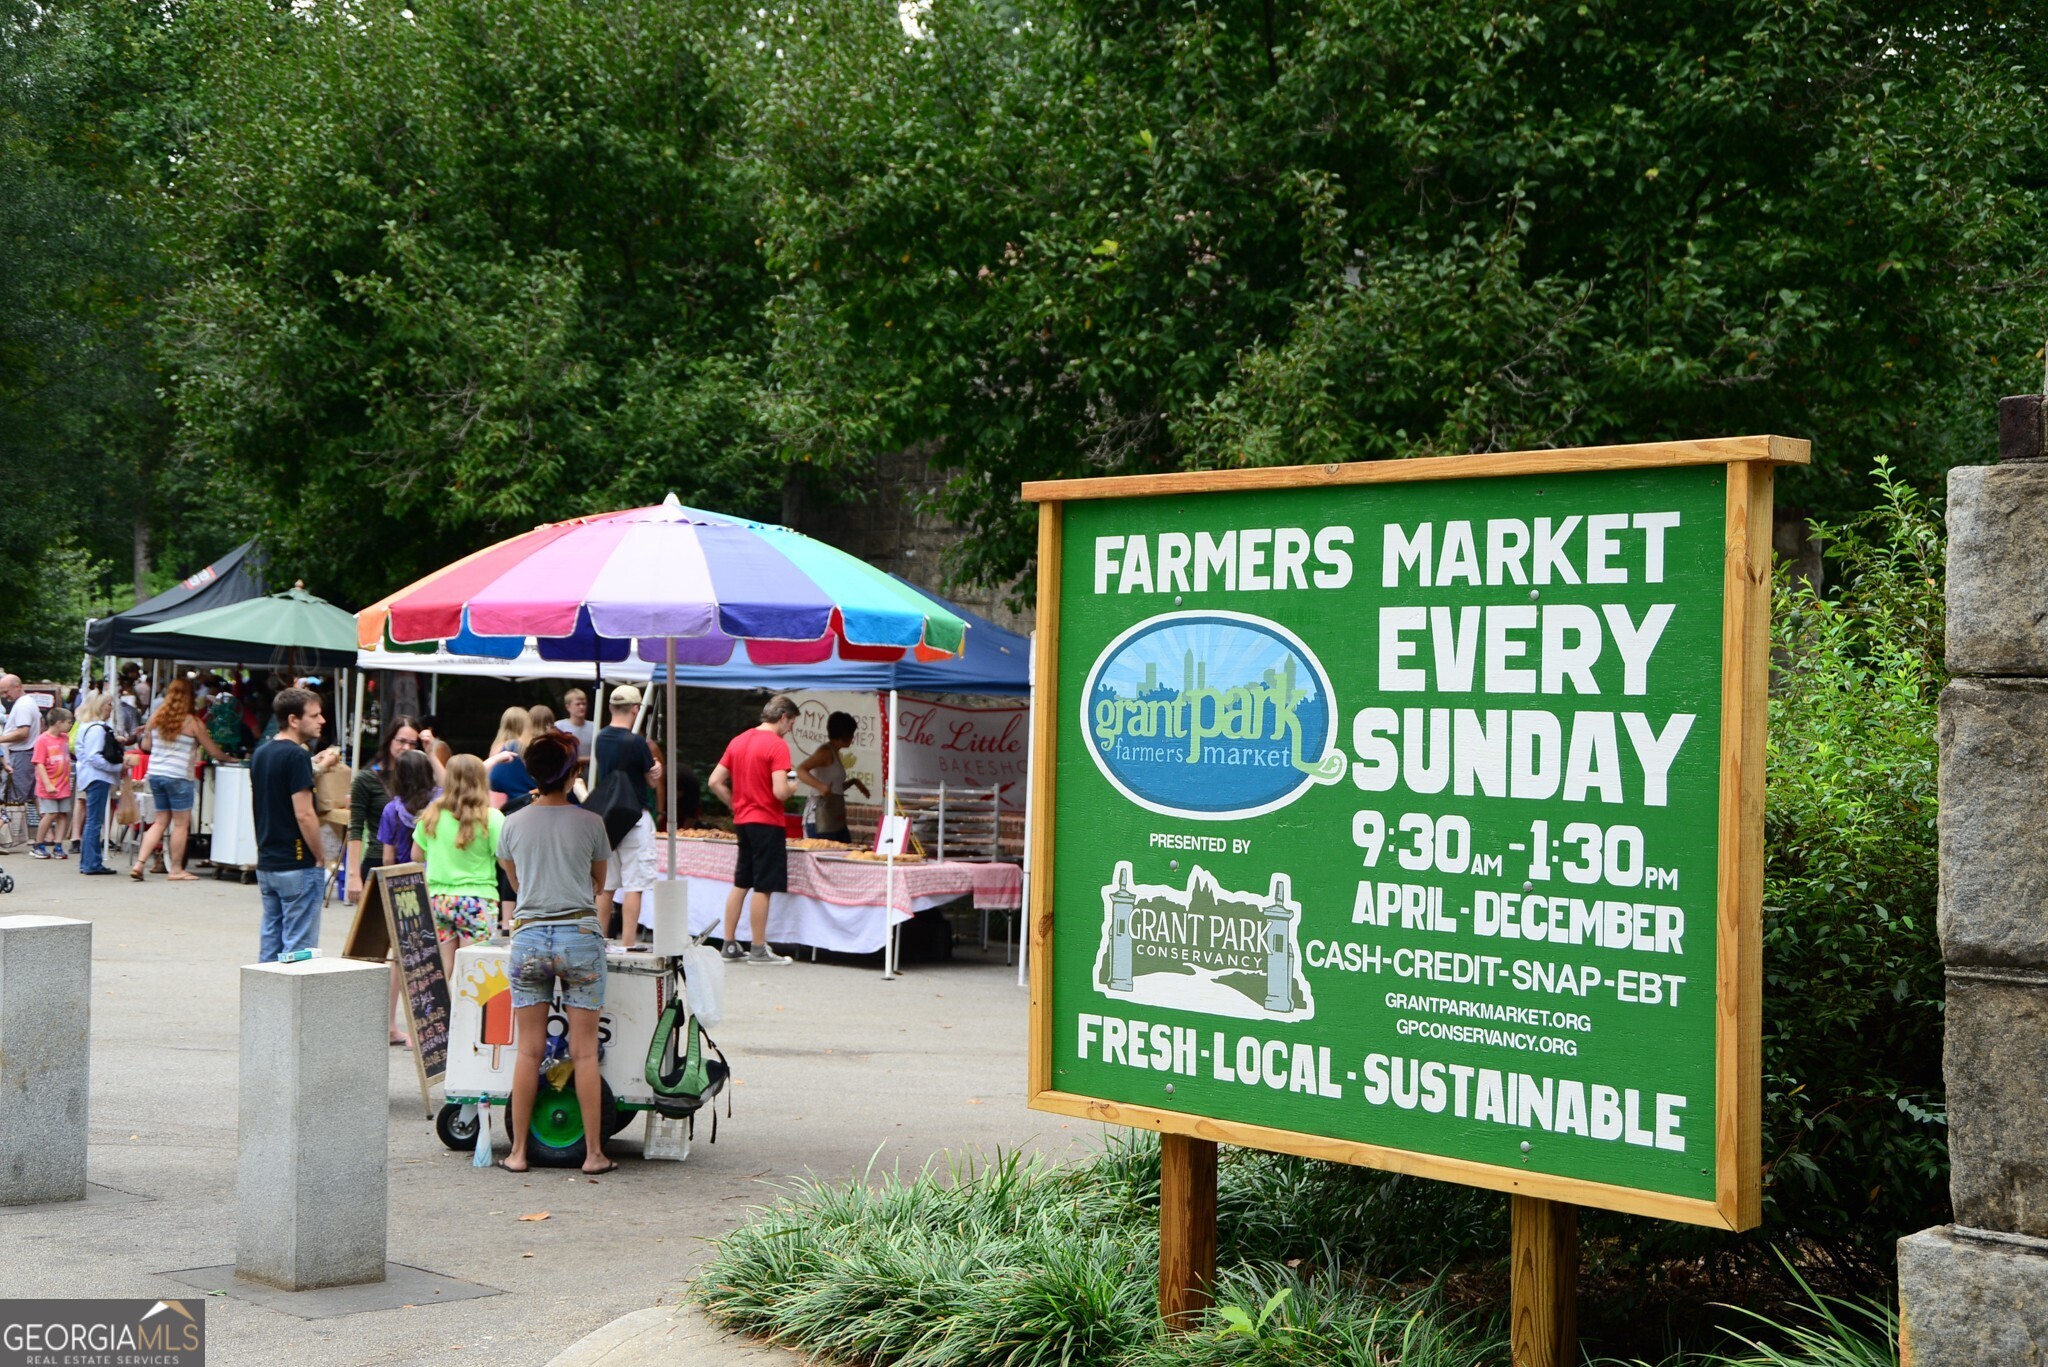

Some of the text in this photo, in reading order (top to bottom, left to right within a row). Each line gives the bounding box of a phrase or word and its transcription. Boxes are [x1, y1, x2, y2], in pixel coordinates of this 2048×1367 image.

[1094, 511, 1681, 595] FARMERS MARKET
[1378, 603, 1677, 696] EVERY
[803, 709, 825, 729] MY
[897, 708, 1023, 753] The Little
[1095, 672, 1346, 781] grant park
[1115, 737, 1291, 768] farmers market
[1351, 707, 1697, 807] SUNDAY
[1149, 832, 1251, 855] PRESENTED BY
[1128, 907, 1274, 956] GRANT PARK
[1136, 944, 1263, 969] CONSERVANCY
[1384, 992, 1591, 1032] GRANTPARKMARKET.ORG
[1396, 1018, 1577, 1057] GPCONSERVANCY.ORG
